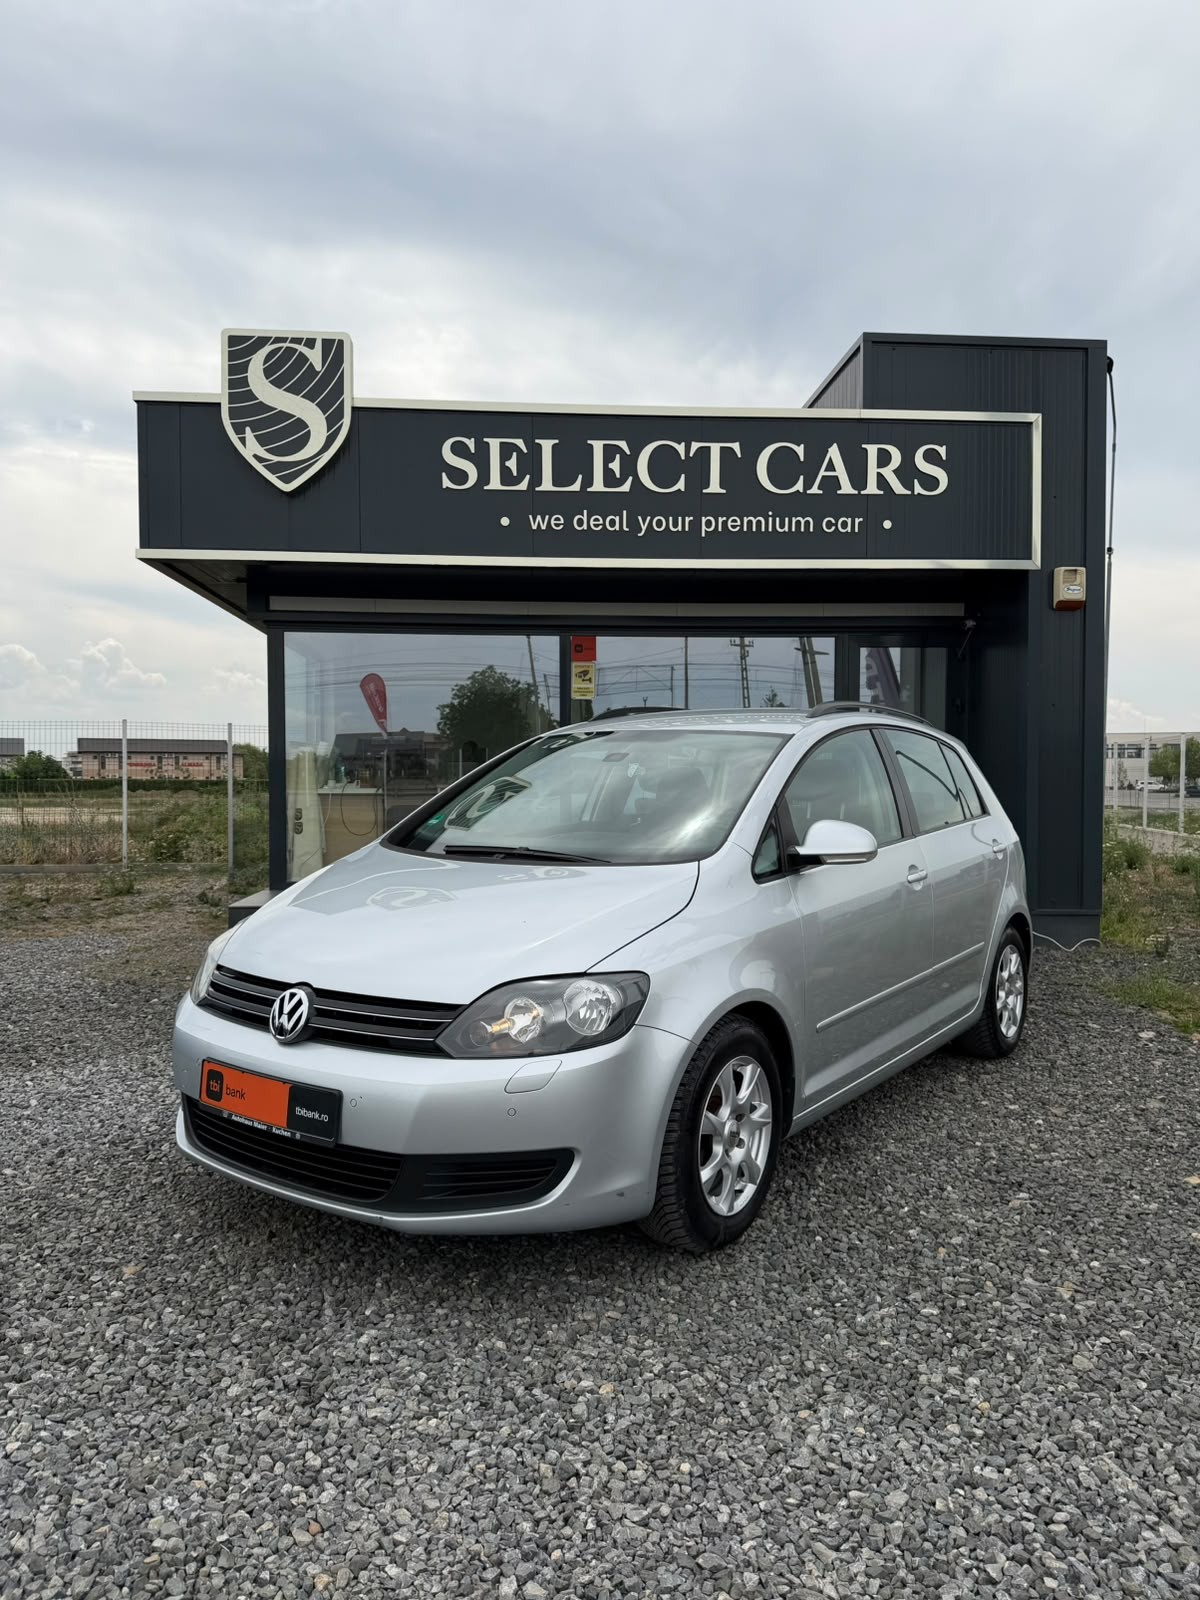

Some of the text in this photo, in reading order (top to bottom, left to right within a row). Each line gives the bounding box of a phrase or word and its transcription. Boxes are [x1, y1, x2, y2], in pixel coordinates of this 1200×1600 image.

[246, 337, 328, 461] S
[441, 436, 949, 496] SELECT CARS
[528, 509, 864, 538] we deal your premium car
[209, 1080, 220, 1092] tbi
[226, 1084, 246, 1100] bank
[231, 1114, 253, 1126] Autohaus
[295, 1106, 329, 1122] tbibank.ro
